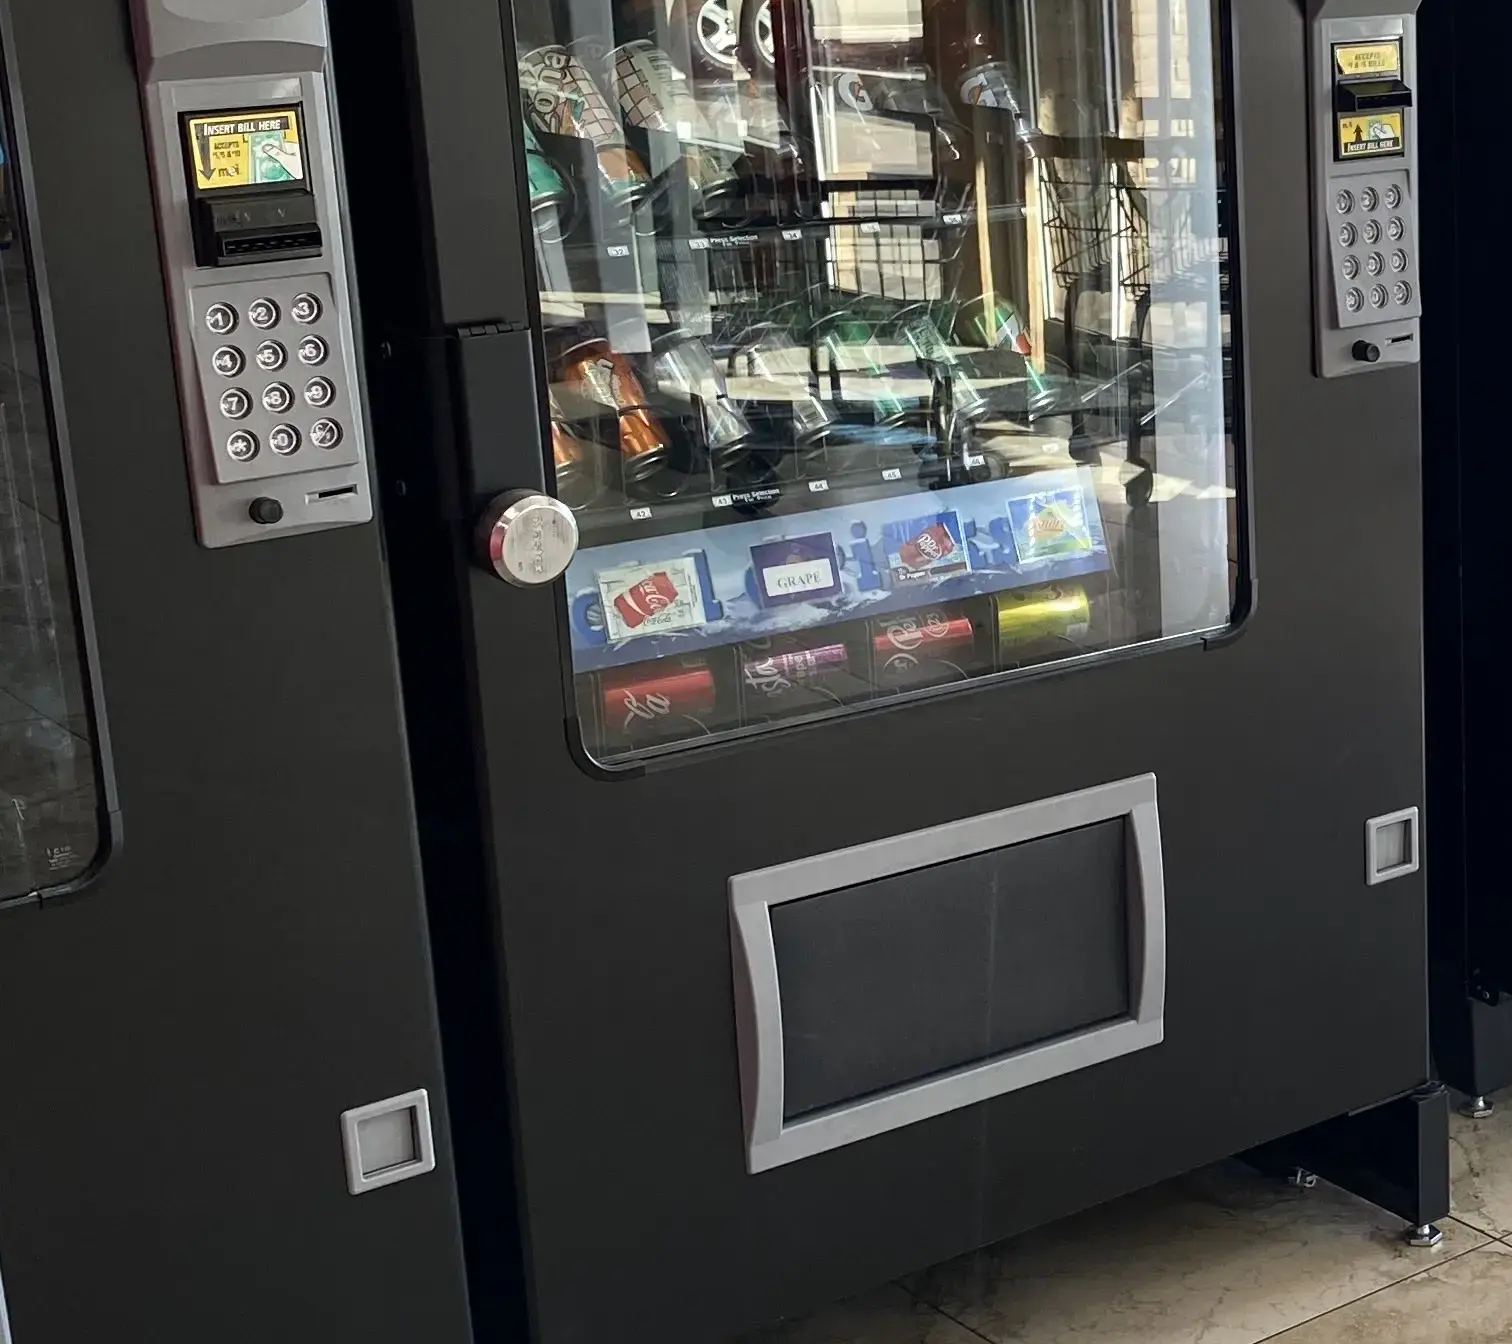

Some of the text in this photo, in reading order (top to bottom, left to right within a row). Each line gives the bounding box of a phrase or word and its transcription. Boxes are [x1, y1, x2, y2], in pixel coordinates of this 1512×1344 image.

[204, 119, 281, 136] INSERT BILL HERE
[777, 571, 821, 589] GRAPE
